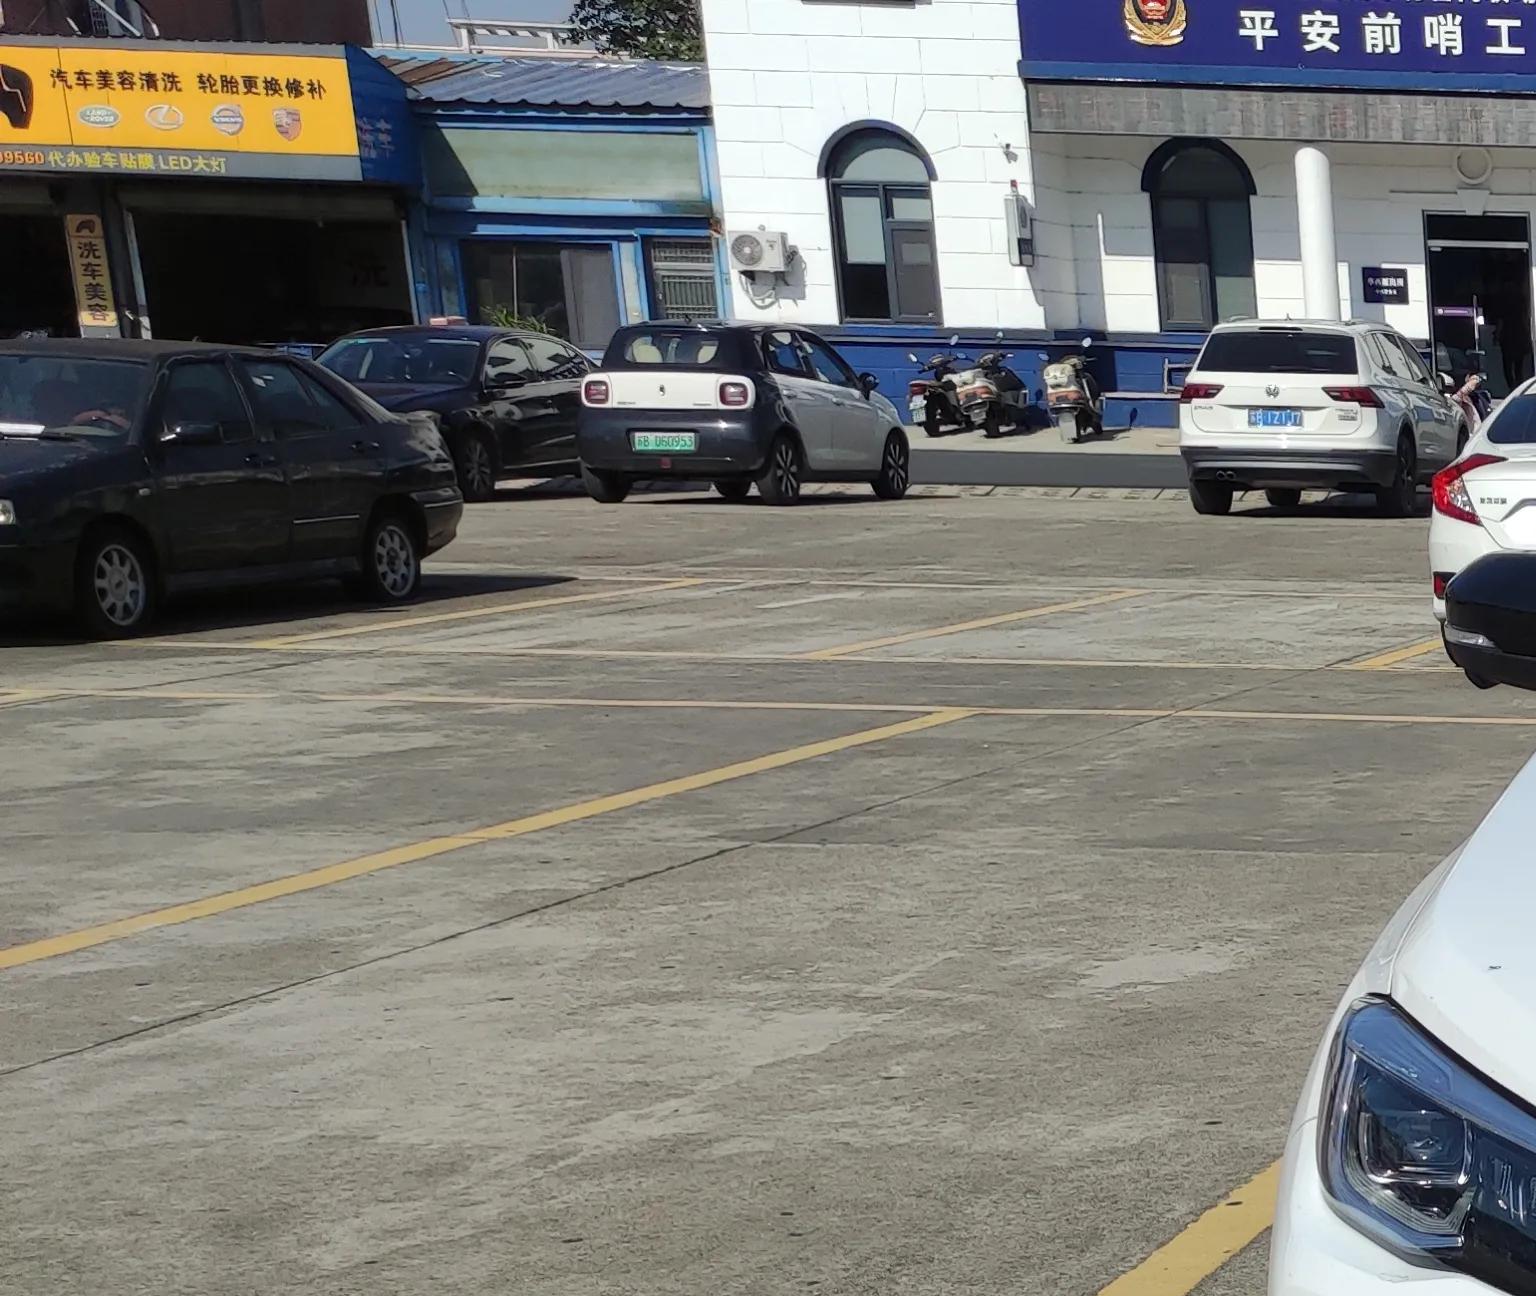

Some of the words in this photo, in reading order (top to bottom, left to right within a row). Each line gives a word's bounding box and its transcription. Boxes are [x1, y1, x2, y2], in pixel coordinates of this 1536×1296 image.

[51, 69, 182, 92] 汽车美容清洗
[197, 73, 326, 100] 轮胎更换修补
[48, 150, 156, 170] 代办验车贴膜
[159, 156, 226, 174] LED大灯
[78, 241, 110, 321] 洗车美容
